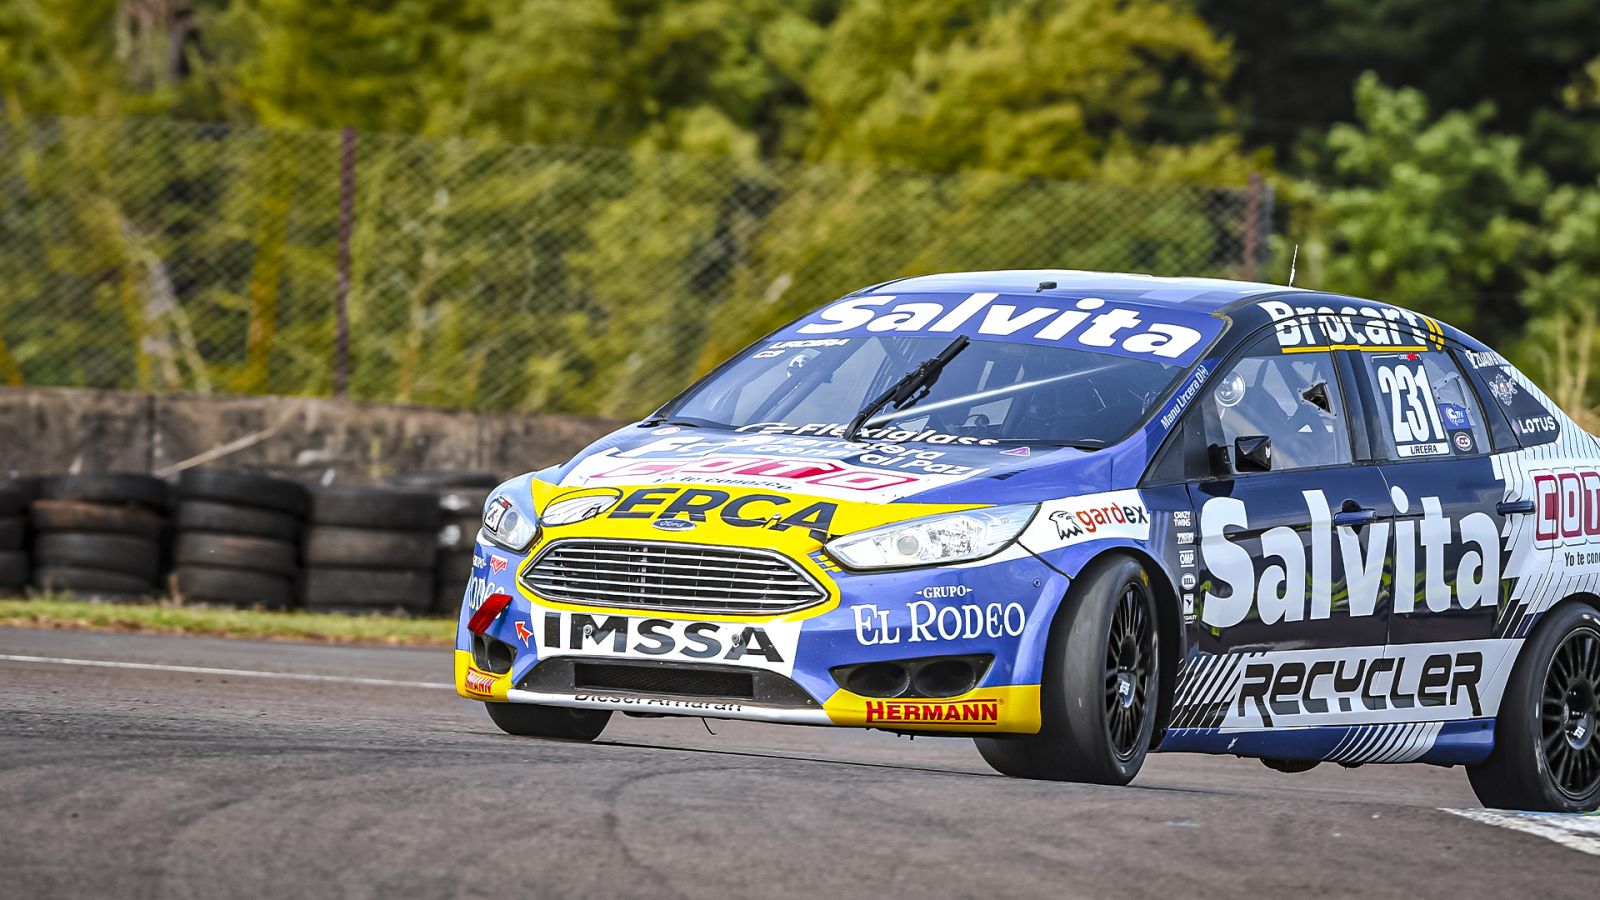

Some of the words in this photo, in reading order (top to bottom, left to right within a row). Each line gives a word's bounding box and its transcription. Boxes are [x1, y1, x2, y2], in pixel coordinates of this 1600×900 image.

[796, 293, 1201, 358] Salvita
[1257, 301, 1427, 346] Brocart
[1160, 404, 1181, 430] Manu
[1177, 380, 1199, 407] Urcera
[1378, 365, 1445, 442] 231
[1519, 416, 1556, 434] LOTUS
[1410, 445, 1438, 454] URCERA
[899, 460, 973, 475] Paz
[1075, 502, 1149, 533] gardex
[1180, 553, 1194, 564] OMP
[1201, 490, 1499, 628] Salvita
[1564, 551, 1575, 567] Yo
[1577, 551, 1584, 566] te
[923, 585, 966, 599] GRUPO
[544, 611, 784, 662] IMSSA
[851, 604, 900, 645] EL
[906, 600, 1026, 642] RODEO
[866, 700, 998, 723] HERMANN
